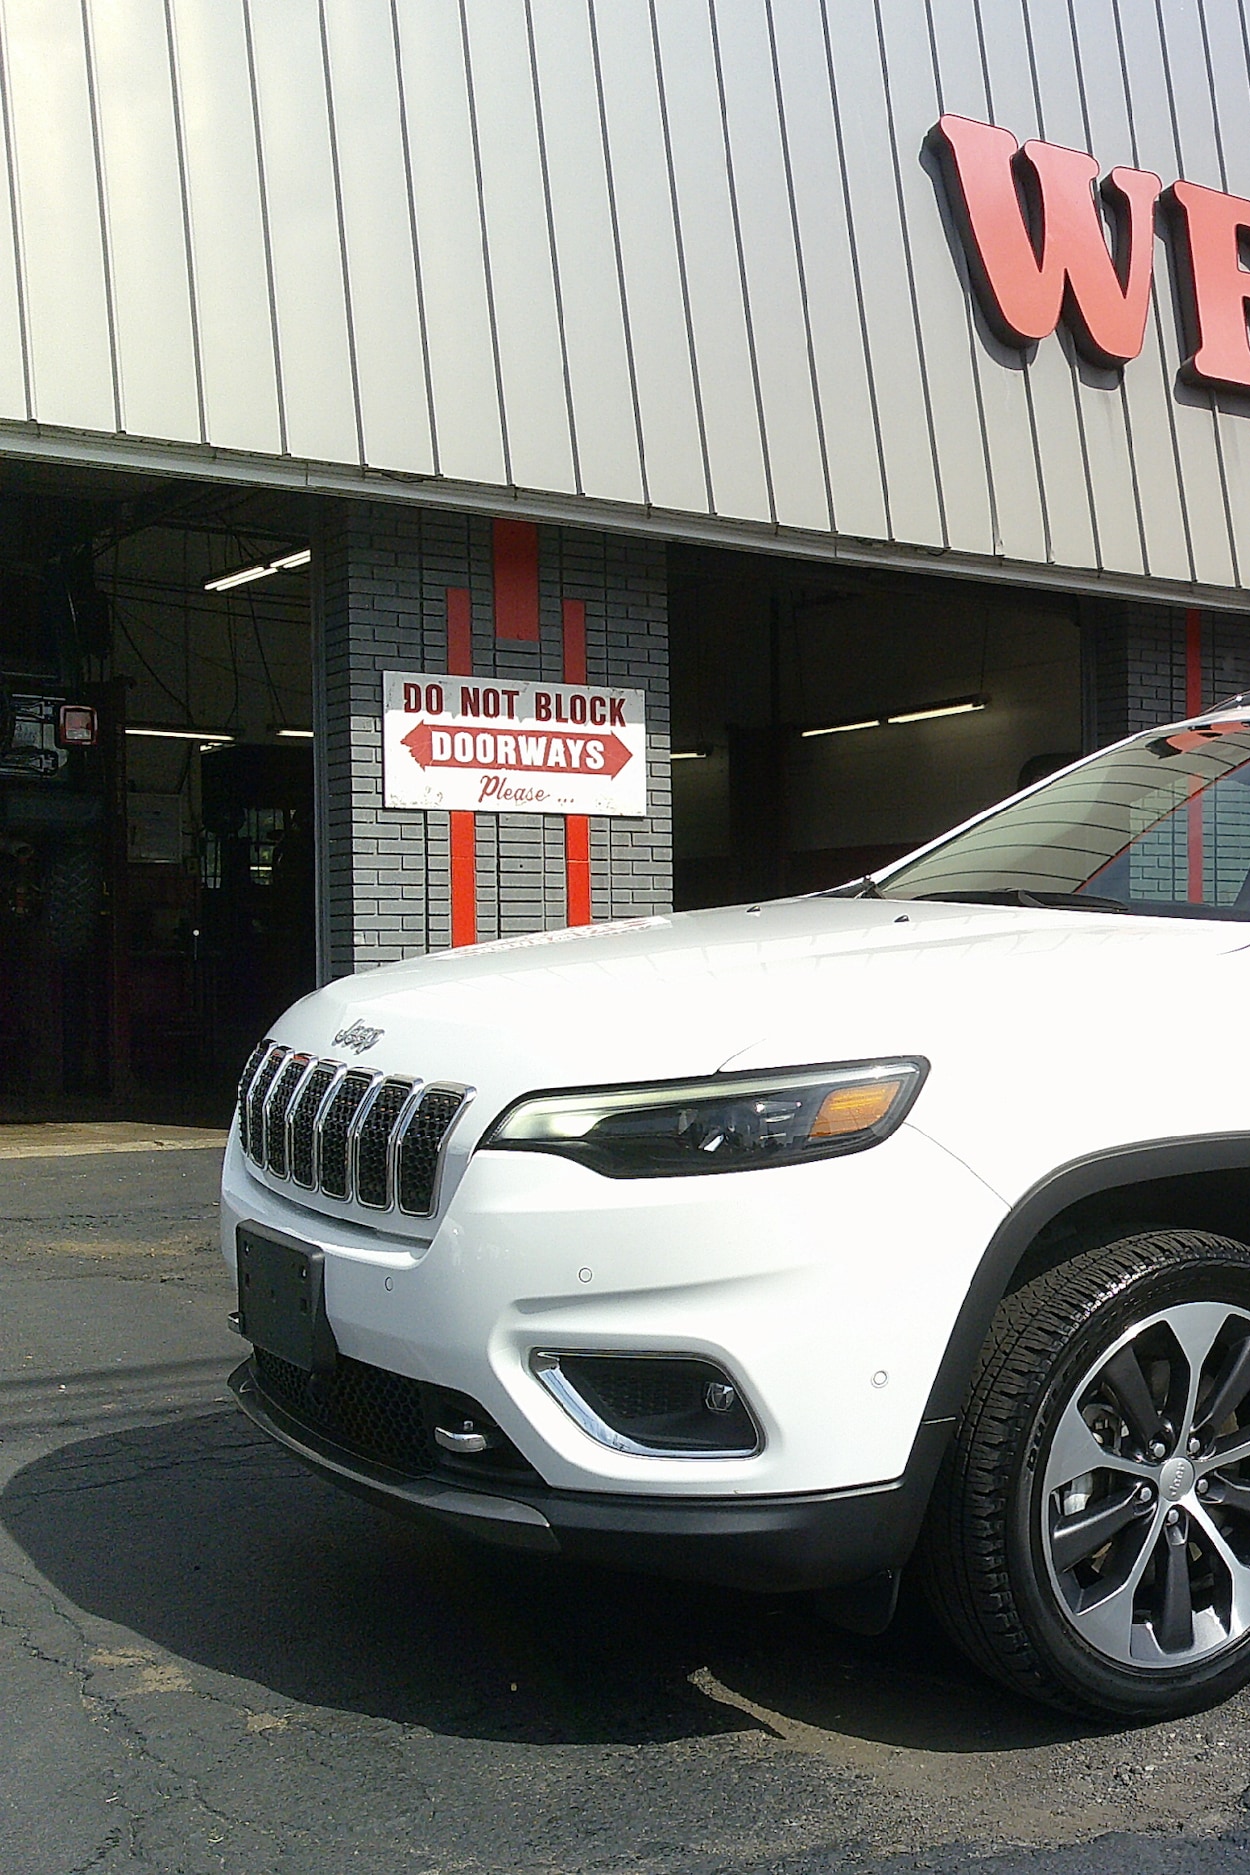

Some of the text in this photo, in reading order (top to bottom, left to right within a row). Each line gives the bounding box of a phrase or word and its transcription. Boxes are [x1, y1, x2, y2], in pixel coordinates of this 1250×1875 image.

[403, 682, 627, 727] DO NOT BLOCK
[431, 730, 605, 770] DOORWAYS
[478, 774, 551, 803] Please
[331, 1018, 386, 1056] Jeep
